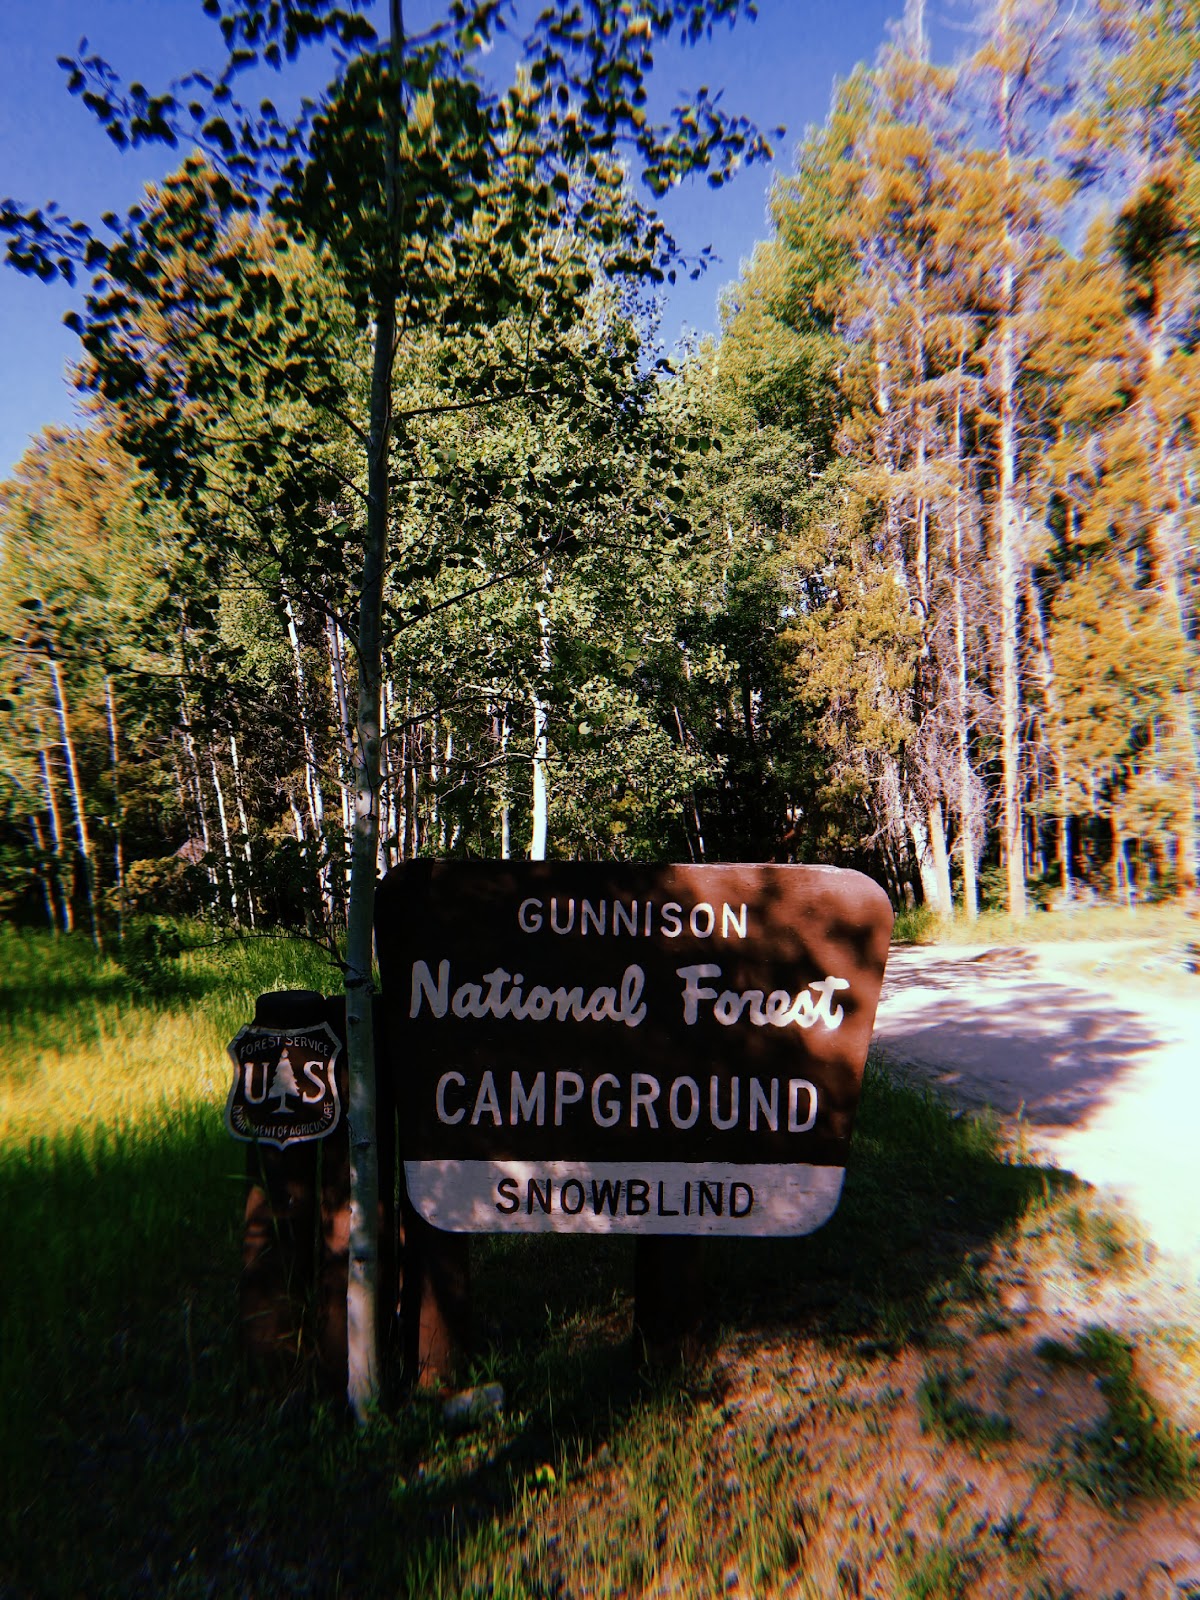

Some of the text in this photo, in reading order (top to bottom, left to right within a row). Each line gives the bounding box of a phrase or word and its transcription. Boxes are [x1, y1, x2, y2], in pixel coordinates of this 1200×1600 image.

[518, 897, 748, 938] GUNNISON
[409, 959, 850, 1029] National Forest
[240, 1036, 330, 1059] FOREST SERVICE
[232, 1101, 334, 1138] DEPARMENT OF AGRICULTURE
[435, 1070, 818, 1132] CAMPGROUND
[495, 1178, 755, 1218] SNOWBLIND
